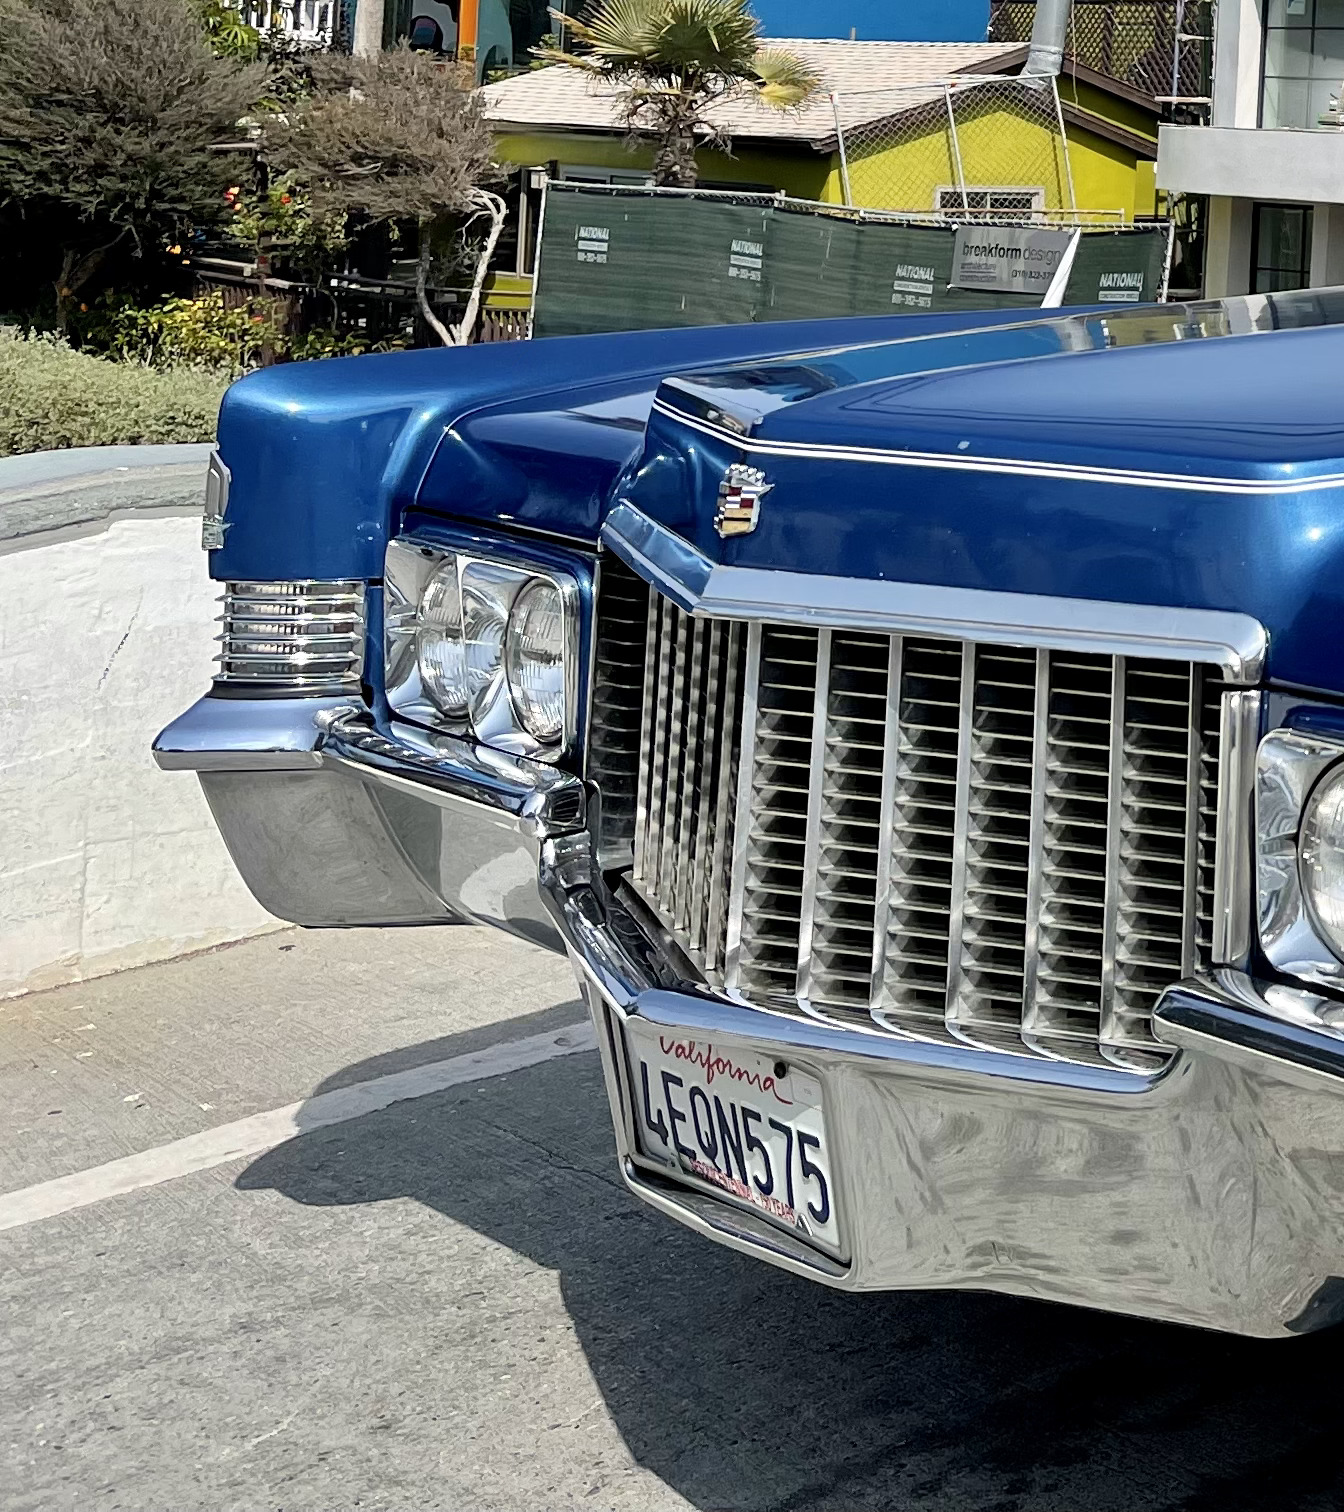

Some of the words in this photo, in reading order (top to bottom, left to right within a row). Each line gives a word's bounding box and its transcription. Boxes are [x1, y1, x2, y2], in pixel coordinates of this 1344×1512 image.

[579, 226, 609, 240] NATIONAL
[731, 239, 763, 256] NATIONAL
[962, 241, 1021, 259] breakform
[1023, 247, 1061, 265] design
[896, 264, 934, 281] NATIONAL
[1099, 272, 1142, 288] NATIONAL
[660, 1036, 793, 1105] California
[641, 1061, 830, 1224] 4EQN575
